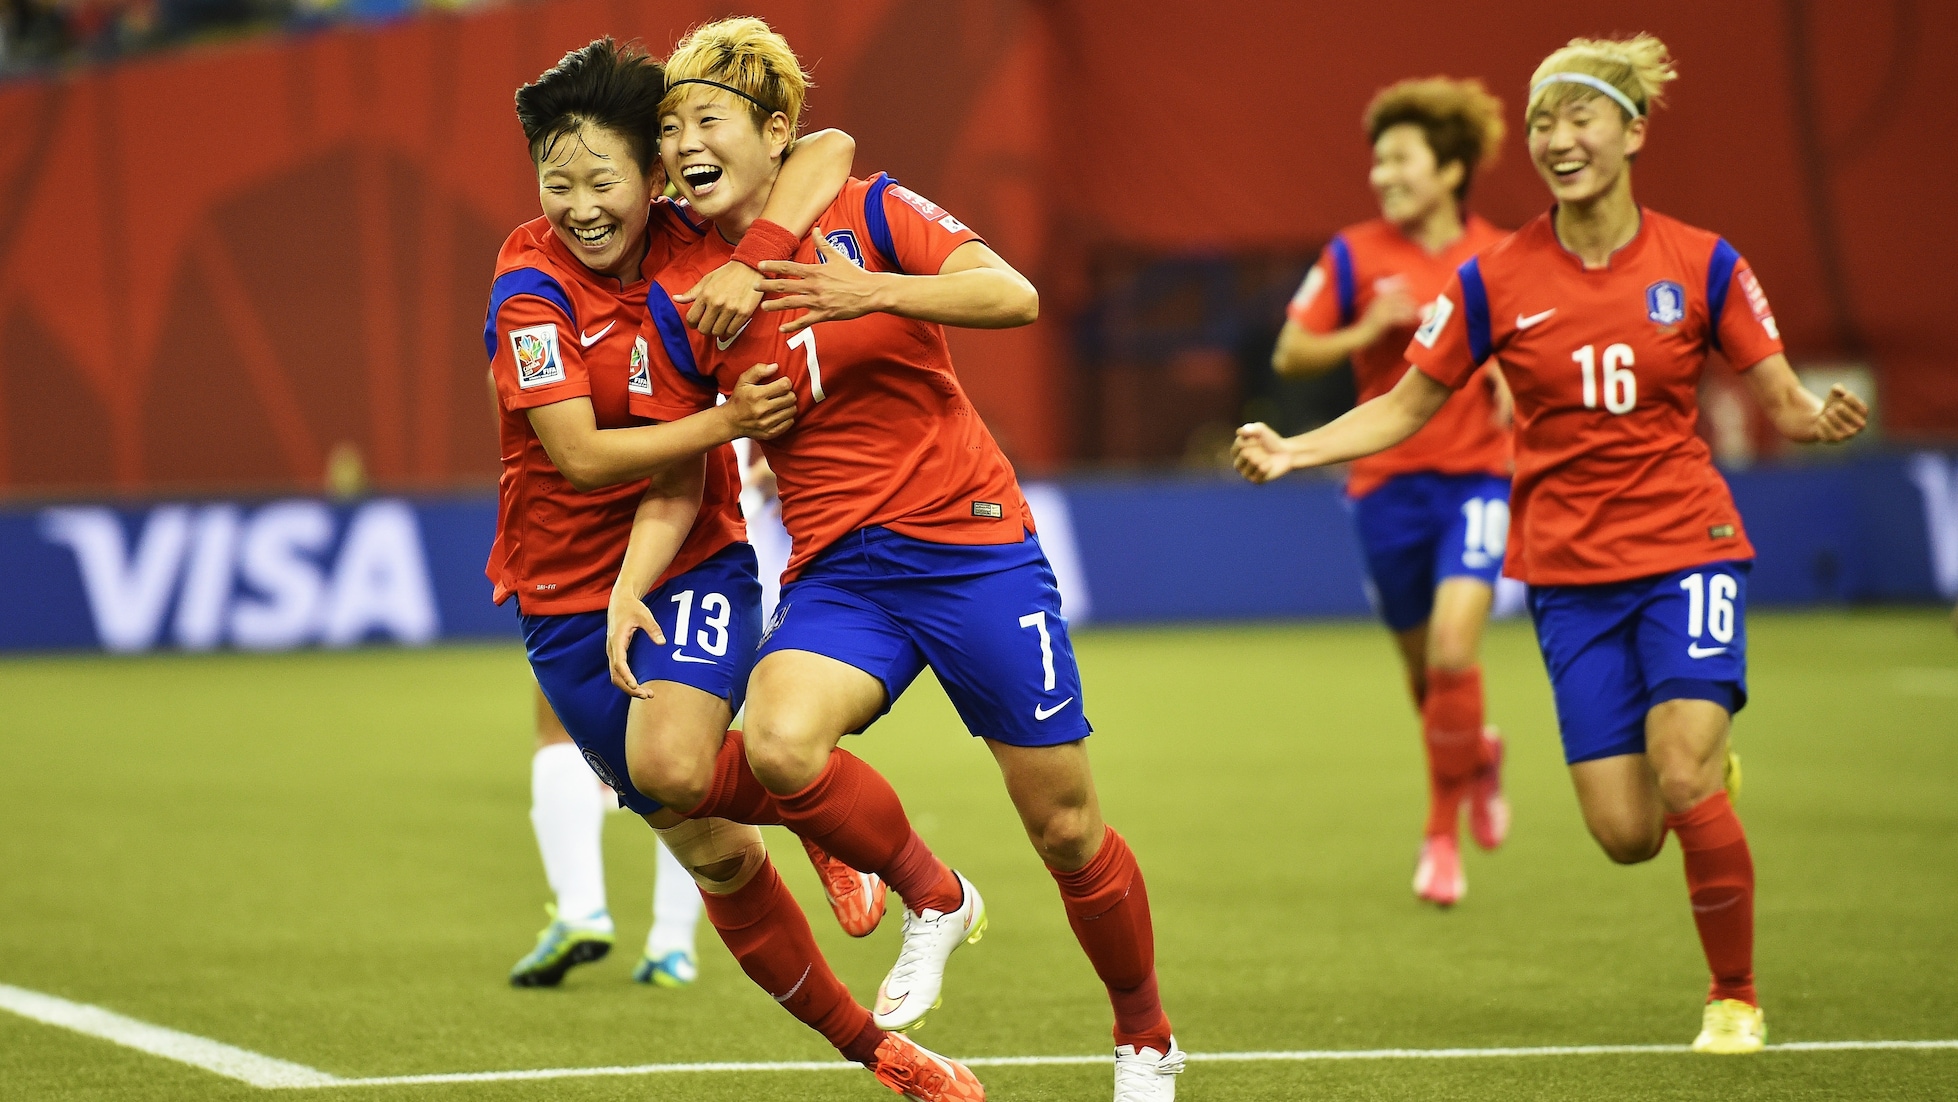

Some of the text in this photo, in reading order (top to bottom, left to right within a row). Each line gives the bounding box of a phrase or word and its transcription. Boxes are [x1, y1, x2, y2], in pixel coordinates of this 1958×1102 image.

[786, 326, 826, 403] 7
[1572, 343, 1637, 415] 16
[1461, 497, 1510, 559] 10
[40, 498, 441, 652] VISA
[1680, 573, 1737, 643] 16
[671, 590, 731, 657] 13
[1018, 611, 1056, 691] 7
